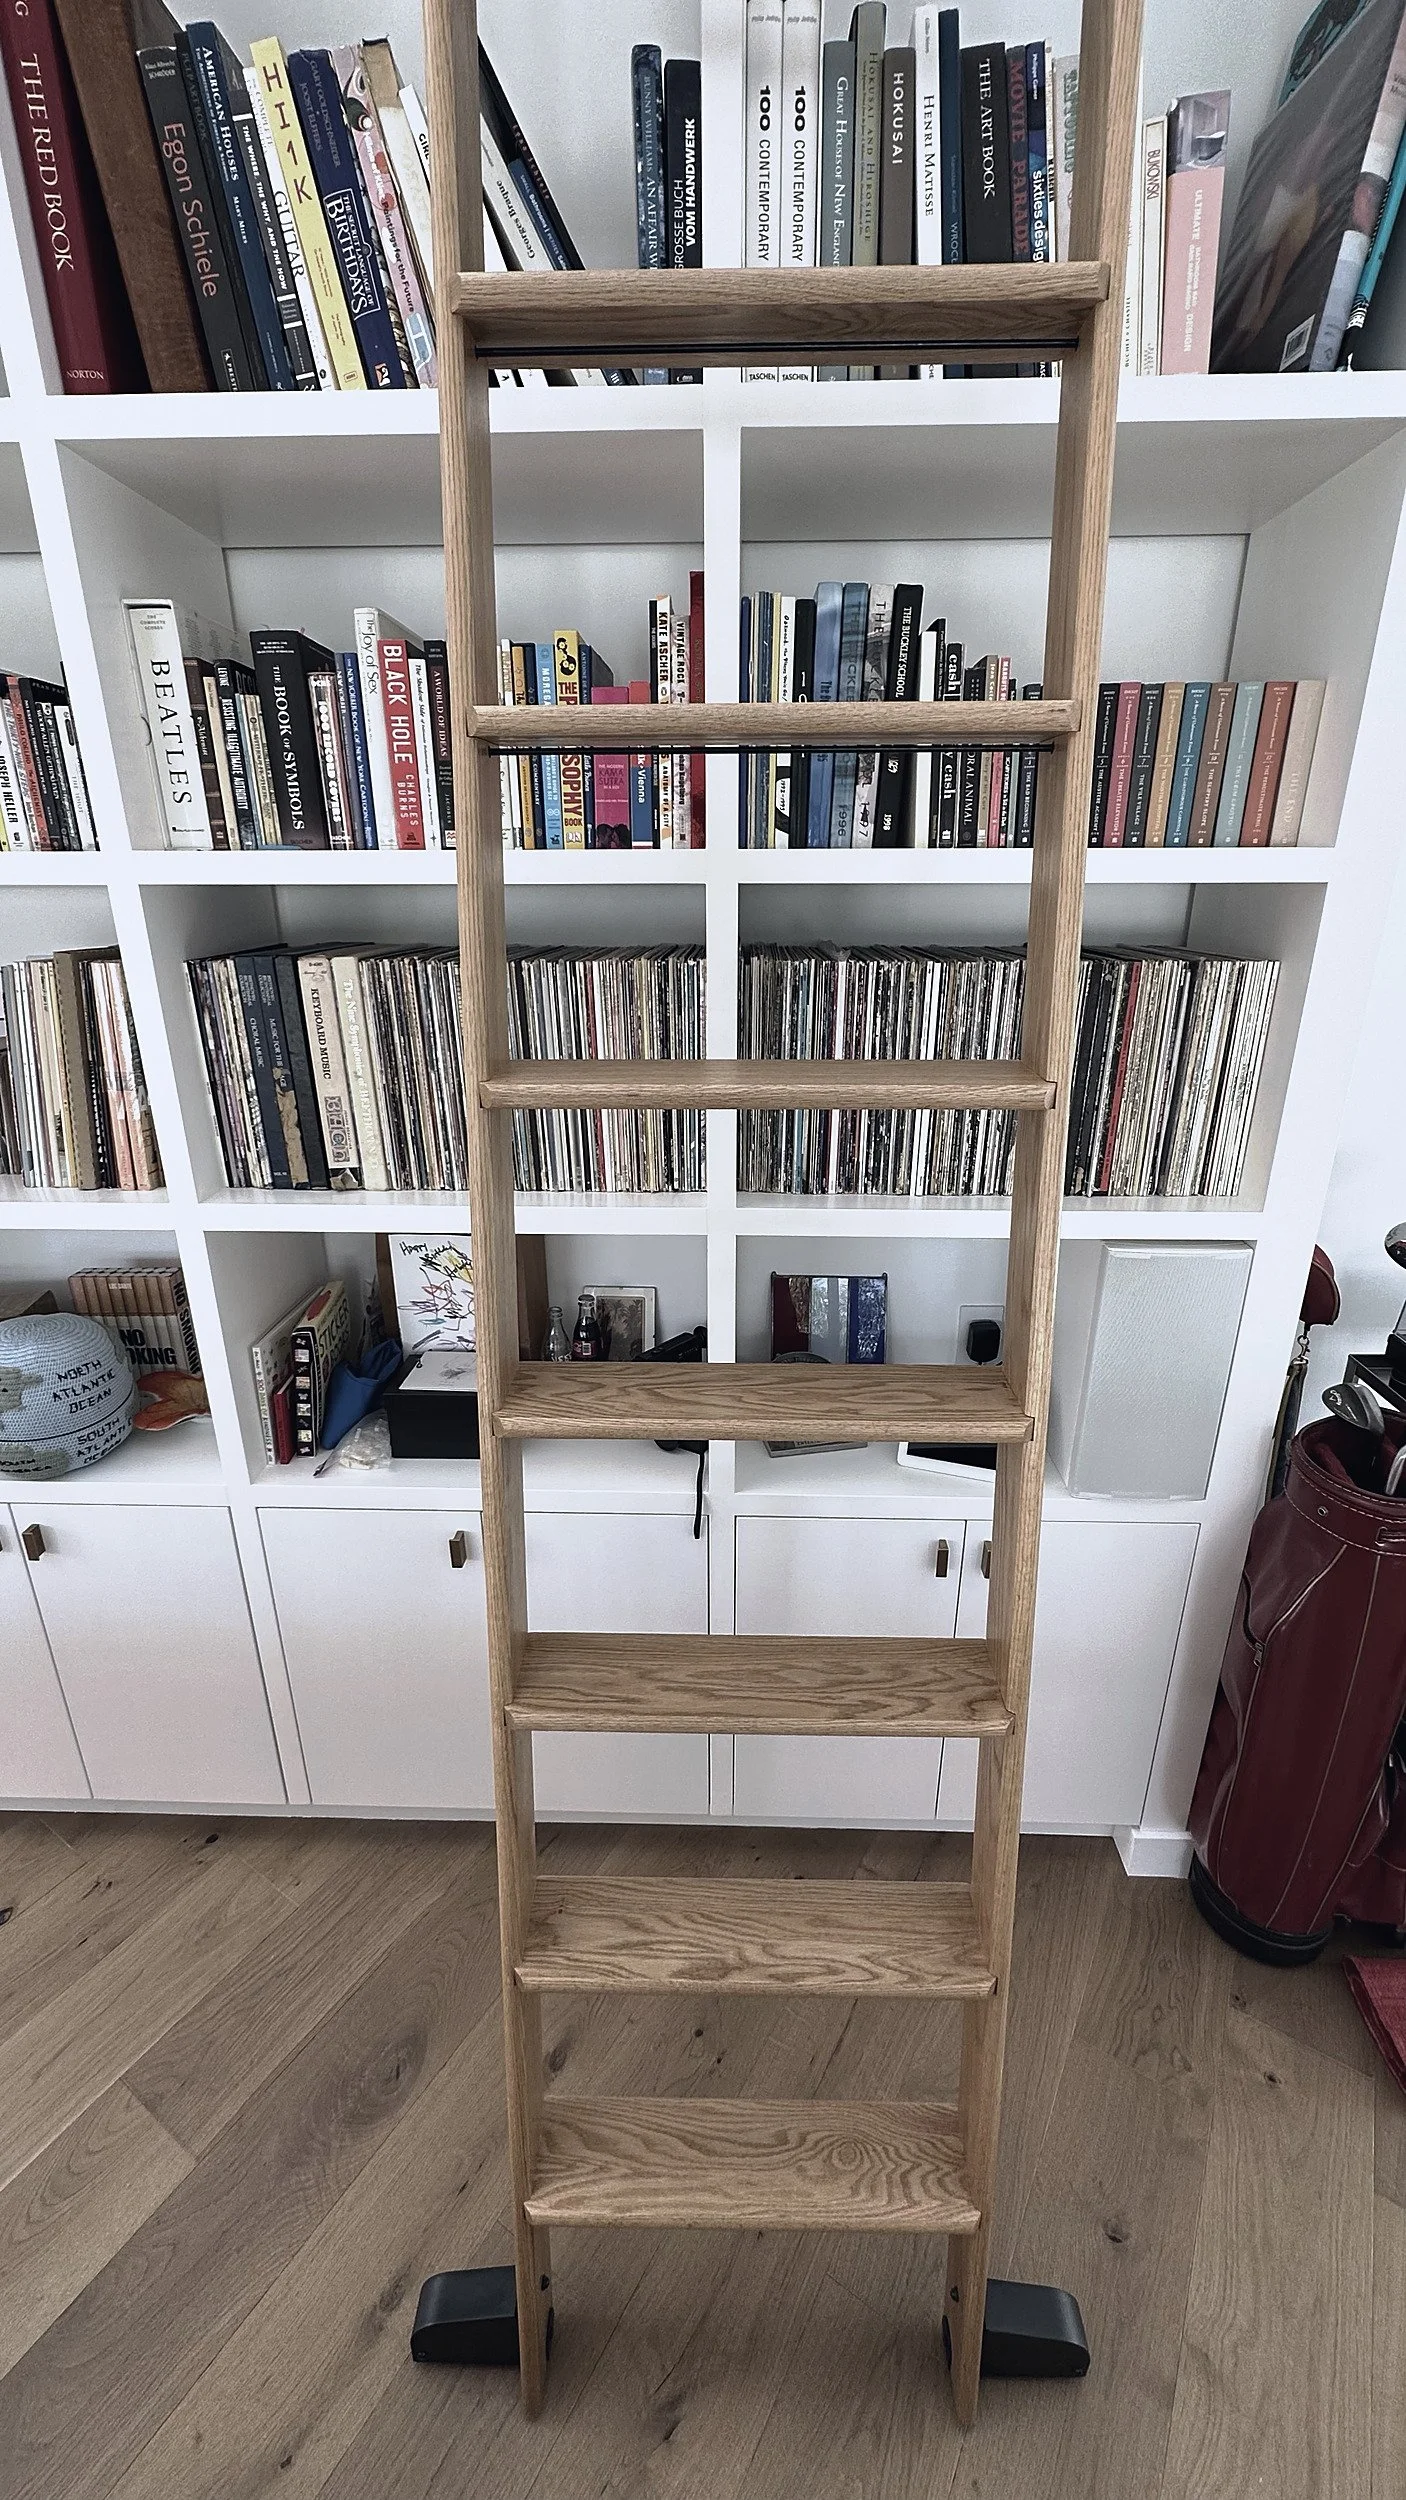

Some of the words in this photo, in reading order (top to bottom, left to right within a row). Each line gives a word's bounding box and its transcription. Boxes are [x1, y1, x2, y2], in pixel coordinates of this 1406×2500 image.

[20, 53, 48, 119] THE
[643, 75, 652, 115] BUNNY
[836, 77, 849, 115] GREAT
[866, 52, 878, 118] HOKUSAI
[979, 58, 992, 100] THE
[201, 46, 226, 121] AMERICAN
[220, 125, 240, 181] HOUSES
[759, 85, 772, 132] 100
[794, 85, 807, 132] 100
[892, 72, 904, 164] HOKUSAI
[1009, 59, 1026, 142] MOVIE
[242, 125, 252, 142] THE
[924, 95, 935, 148] HENRI
[980, 105, 993, 141] ART
[32, 126, 59, 187] RED
[644, 118, 654, 175] WILLIAMS
[835, 120, 848, 162] HOUSES
[866, 128, 874, 155] AND
[685, 118, 697, 213] HANDWERK
[834, 165, 844, 181] OF
[982, 147, 996, 200] BOOK
[1147, 148, 1161, 200] BUKOWSKI
[255, 181, 266, 199] THE
[496, 180, 517, 218] Braque
[646, 177, 657, 203] AN
[673, 178, 684, 219] BUCH
[757, 139, 771, 262] CONTEMPORARY
[792, 139, 806, 262] CONTEMPORARY
[834, 184, 846, 216] NEW
[864, 163, 875, 242] HIROSHIGE
[925, 153, 935, 217] MATISSE
[1032, 170, 1043, 219] sixties
[162, 122, 193, 193] Egon
[182, 199, 220, 298] Schiele
[232, 196, 243, 219] MARY
[238, 220, 248, 244] MIERS
[260, 201, 272, 223] WHY,
[341, 194, 352, 214] THE
[529, 193, 548, 229] Bathrooms
[1012, 159, 1029, 254] PARADE
[1192, 189, 1203, 241] ULTIMATE
[43, 191, 75, 271] BOOK
[266, 227, 277, 247] AND
[274, 190, 305, 277] GUITAR
[346, 214, 360, 247] SECRET
[513, 217, 536, 259] Georges
[647, 204, 658, 248] AFFAIR
[686, 216, 697, 248] VOM
[272, 248, 282, 270] THE
[326, 196, 368, 313] BIRTHDAYS
[355, 247, 372, 293] LANGUAGE
[379, 200, 399, 248] Paintings
[401, 280, 416, 312] Future
[277, 271, 288, 290] HOW
[66, 369, 104, 381] NORTON
[749, 373, 776, 381] TASCHEN
[782, 373, 809, 381] TASCHEN
[658, 611, 668, 635] KATE
[901, 606, 912, 624] THE
[362, 631, 374, 653] Joy
[676, 621, 686, 658] VINTAGE
[897, 625, 910, 662] BUCKLEY
[272, 666, 282, 685] THE
[383, 645, 408, 705] BLACK
[660, 640, 669, 682] ASCHER
[677, 660, 686, 683] ROCK
[948, 653, 962, 692] cash
[366, 670, 379, 695] Sex
[416, 677, 424, 702] Shadow
[434, 679, 444, 717] WORLD
[558, 681, 578, 694] THE
[894, 663, 906, 698] SCHOOL
[15, 712, 26, 736] PAULO
[220, 696, 236, 731] RESISTING
[274, 685, 293, 735] BOOK
[317, 699, 330, 732] 1000
[437, 719, 446, 733] OF
[150, 659, 193, 805] BEATLES
[283, 735, 292, 749] OF
[390, 715, 413, 765] HOLE
[439, 733, 448, 757] IDEAS
[20, 736, 31, 764] COELHO
[225, 731, 244, 775] ILLEGITIMATE
[320, 732, 336, 779] RECORD
[530, 763, 542, 805] COMMENTARY
[599, 768, 624, 777] KAMA
[599, 776, 624, 786] SUTRA
[637, 769, 646, 804] Vienna
[943, 764, 956, 799] cash
[1207, 768, 1215, 781] THE
[3, 790, 19, 824] HELLER
[233, 775, 249, 811] AUTHORITY
[284, 751, 305, 831] SYMBOLS
[326, 779, 342, 822] COVERS
[396, 781, 409, 819] BURNS
[405, 774, 419, 826] CHARLES
[964, 784, 975, 825] ANIMAL
[1094, 780, 1103, 804] AUSTERE
[1202, 781, 1213, 807] SLIPPERY
[564, 818, 583, 827] BOOK
[838, 804, 848, 837] 1996
[883, 813, 892, 831] 1998
[1021, 796, 1031, 827] BEGINNING
[1091, 805, 1100, 831] ACADEMY
[1112, 803, 1121, 831] ELEVATOR
[1133, 801, 1142, 825] VILLAGE
[1199, 808, 1209, 827] SLOPE
[343, 979, 354, 994] The
[346, 996, 357, 1016] Nine
[249, 1017, 260, 1045] CHORAL
[269, 1018, 278, 1040] MUSIC
[310, 988, 328, 1047] KEYBOARD
[320, 1047, 332, 1080] MUSIC
[349, 1018, 365, 1075] Symphonies
[254, 1046, 265, 1068] MUSIC
[273, 1040, 281, 1056] FOR
[173, 1281, 187, 1307] NO
[119, 1329, 145, 1347] NO
[319, 1298, 350, 1358] STICKER
[52, 1369, 116, 1402] ATLANTIC
[57, 1360, 102, 1382] NORTH
[69, 1388, 112, 1414] OCEAN
[77, 1418, 120, 1445] SOUTH
[77, 1417, 132, 1457] ATLANTIC
[83, 1438, 122, 1464] OCEAN
